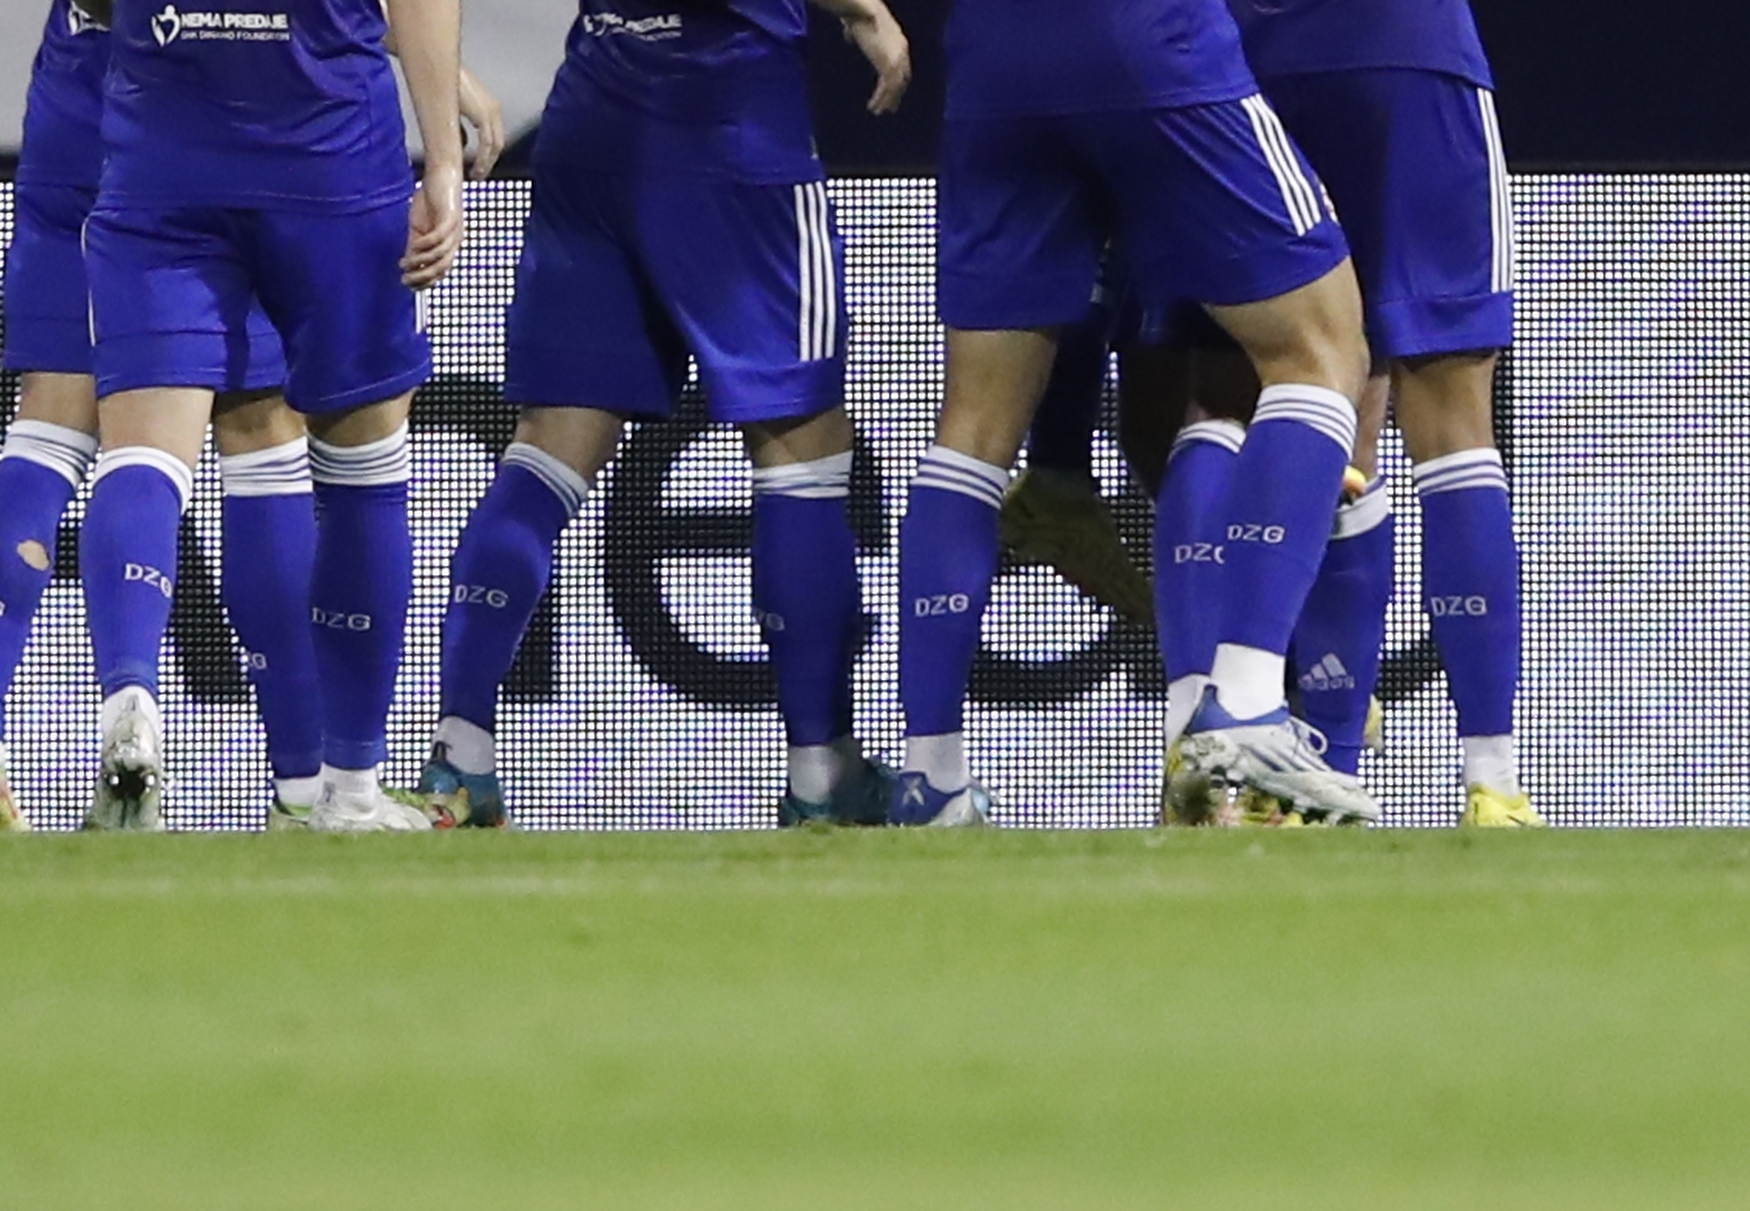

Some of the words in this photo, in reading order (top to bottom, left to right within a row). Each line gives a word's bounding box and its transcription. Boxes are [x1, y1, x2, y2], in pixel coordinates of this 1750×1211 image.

[181, 13, 223, 28] NEMA
[224, 13, 289, 29] PREDAJE
[1228, 524, 1285, 544] DZG
[125, 563, 172, 599] DZG
[453, 584, 508, 609] DZG
[914, 593, 969, 617] DZG
[1430, 595, 1488, 618] DZG
[311, 607, 371, 632] DZG
